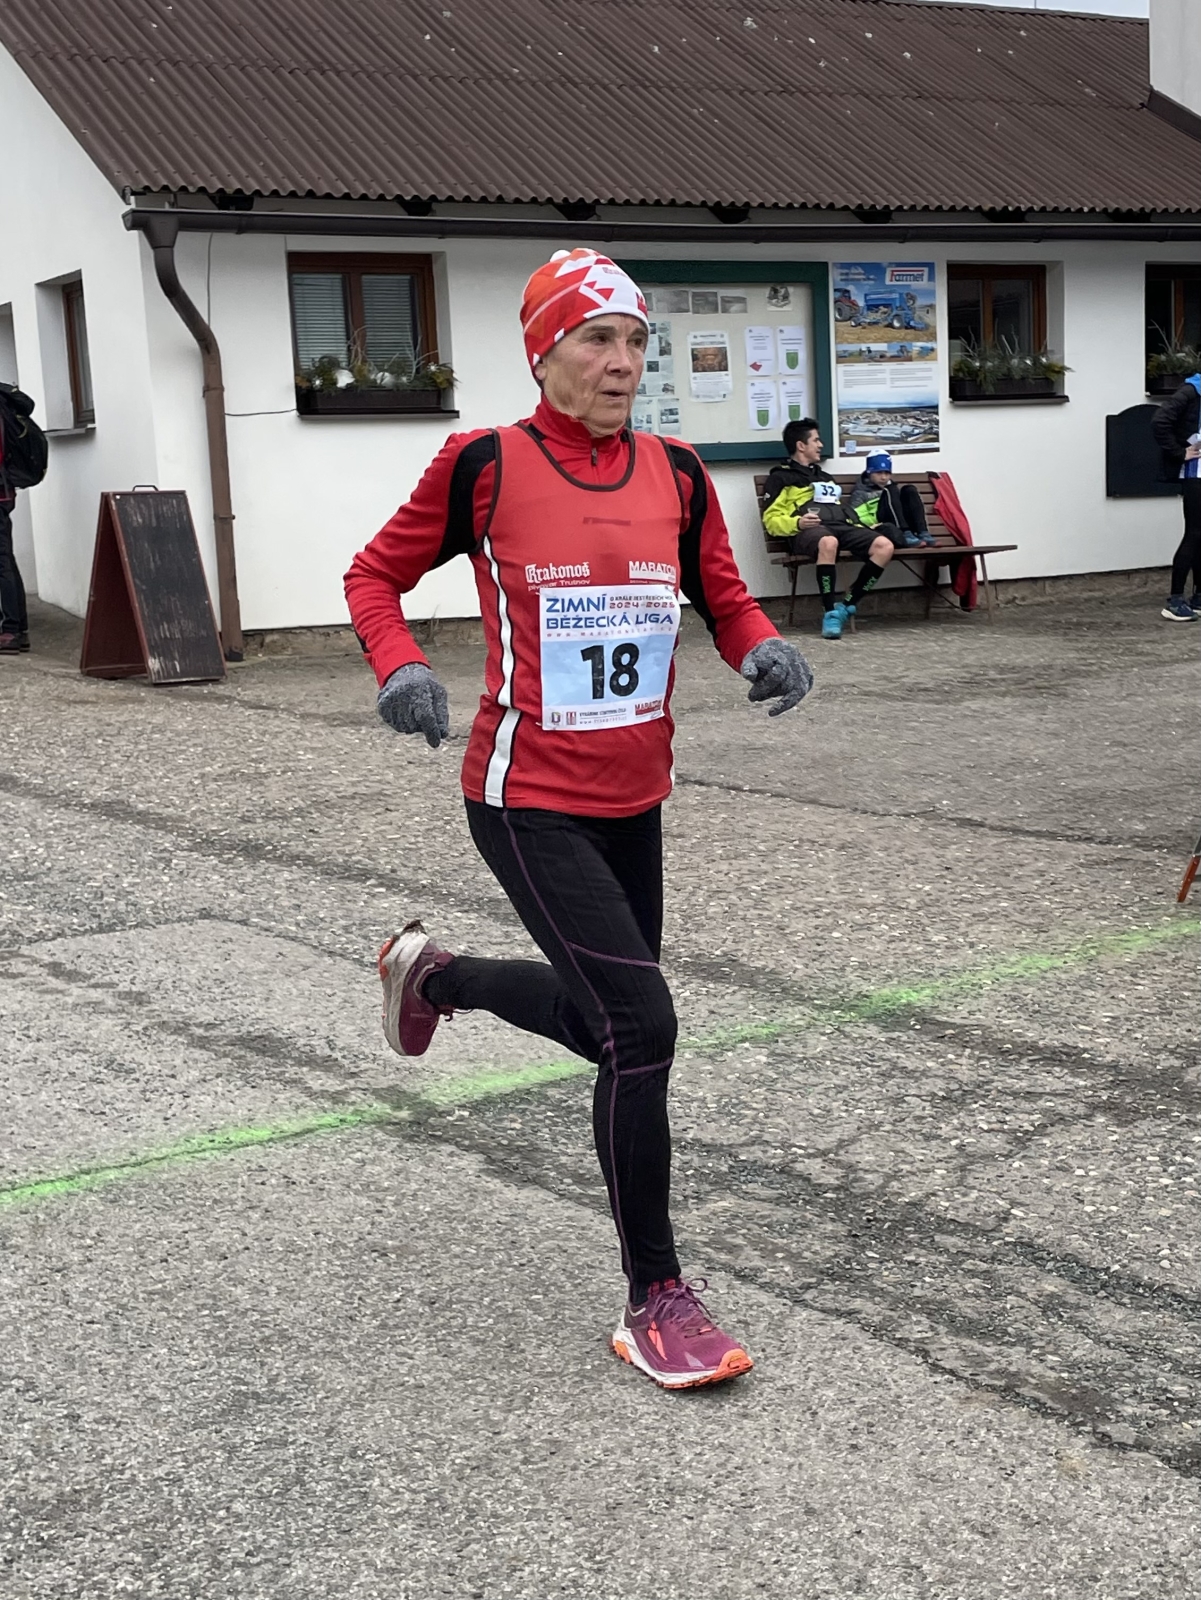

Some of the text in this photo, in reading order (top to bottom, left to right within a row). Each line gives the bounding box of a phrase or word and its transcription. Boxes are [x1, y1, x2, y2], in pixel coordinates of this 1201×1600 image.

[889, 269, 925, 283] Farmet
[820, 484, 837, 497] 32
[525, 561, 591, 584] Krakonoš
[628, 560, 677, 577] MARATON
[559, 579, 591, 587] Trutnov
[545, 593, 607, 613] ZIMNÍ
[546, 612, 674, 630] BĚŽECKÁ LIGA
[580, 643, 640, 700] 18
